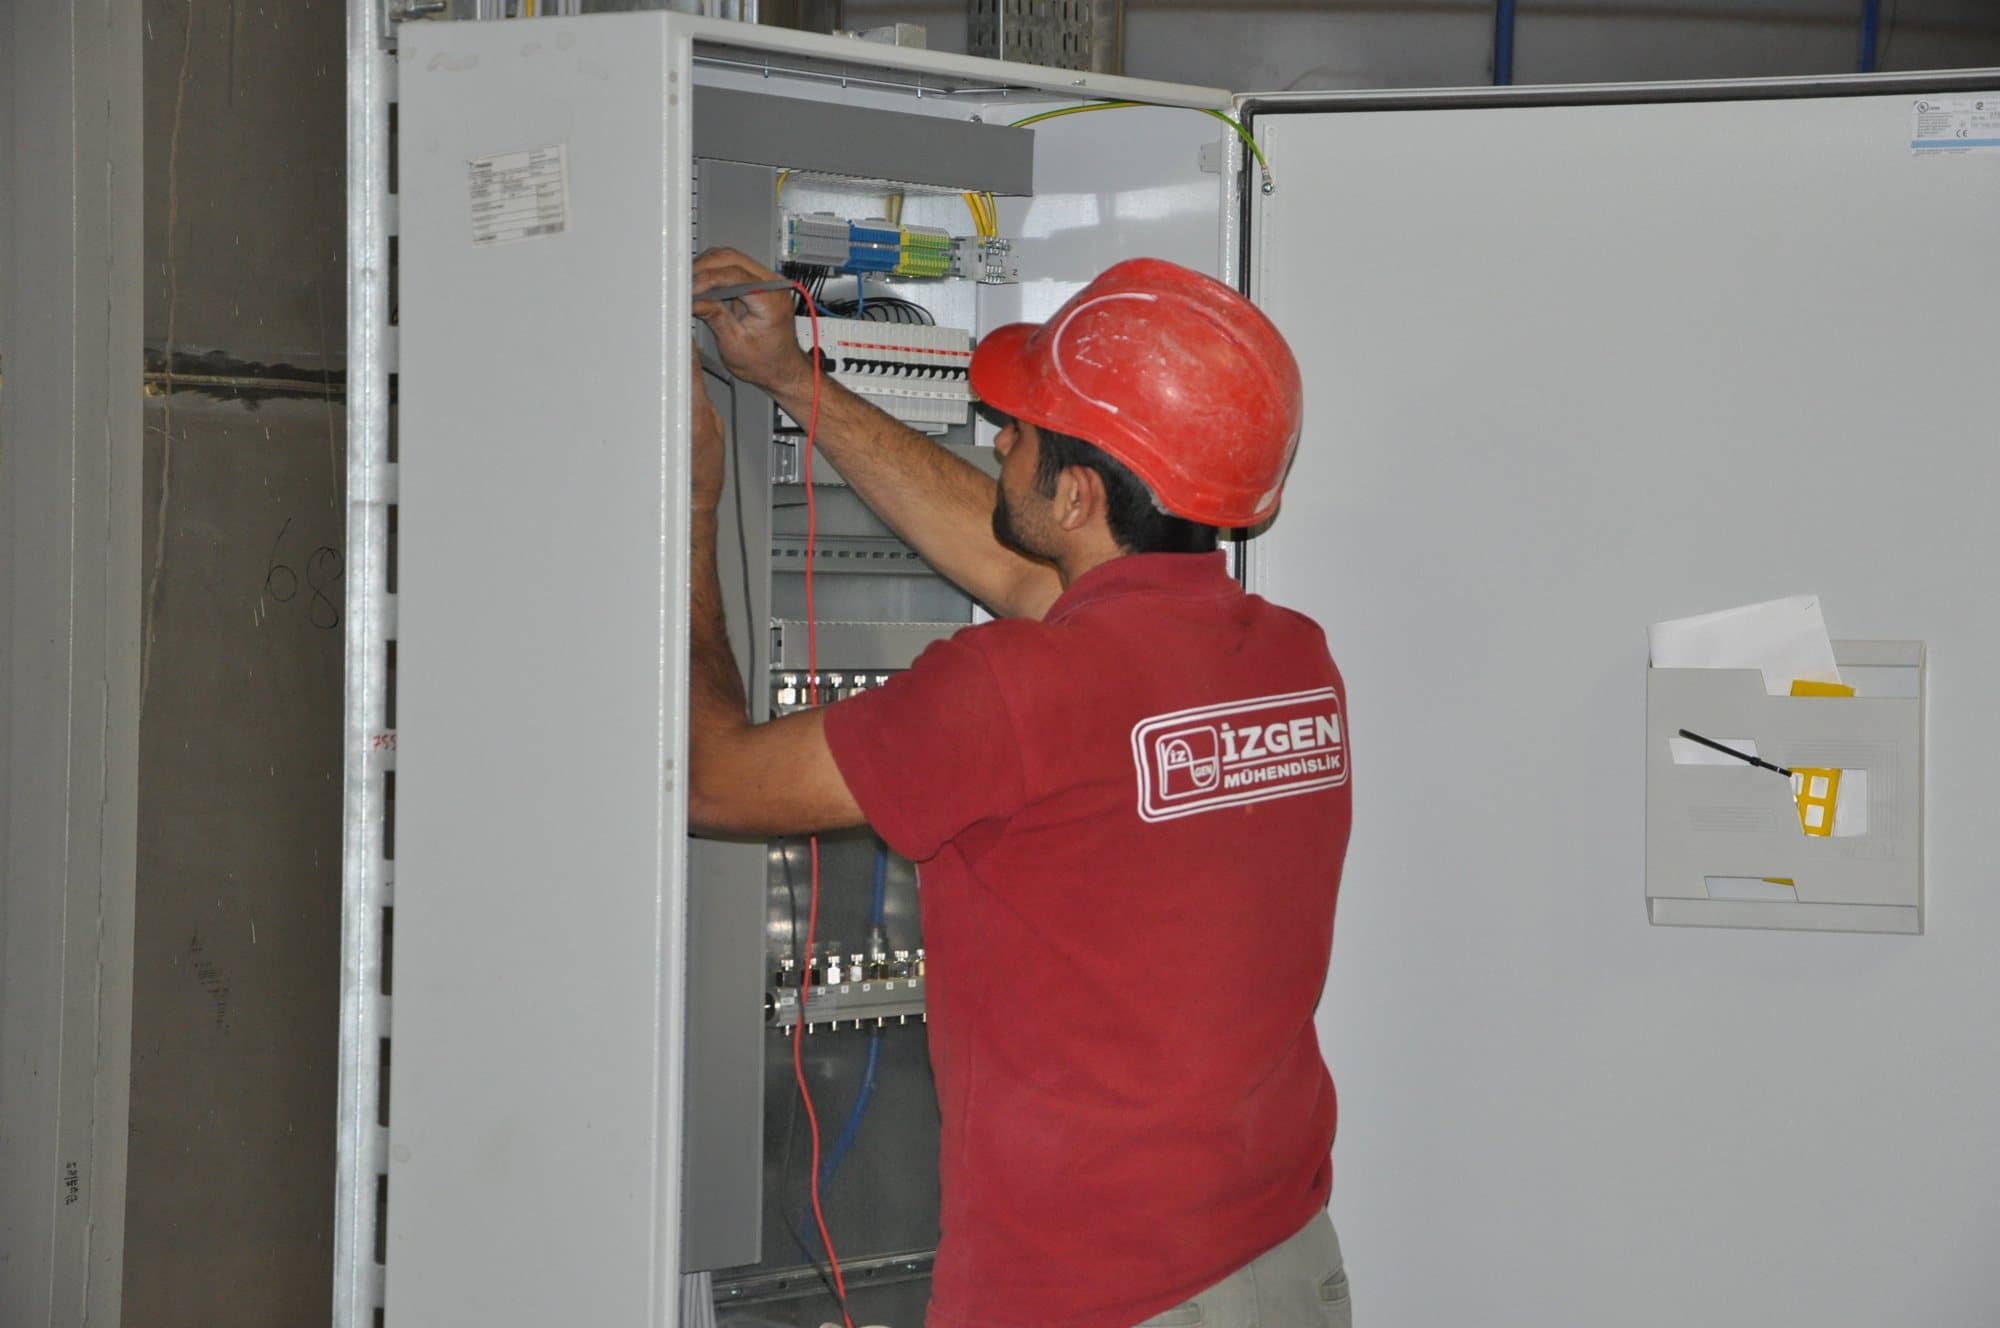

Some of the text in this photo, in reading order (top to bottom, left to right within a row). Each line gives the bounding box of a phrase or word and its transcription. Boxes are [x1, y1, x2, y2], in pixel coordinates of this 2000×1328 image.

[1220, 713, 1342, 764] İZGEN
[1193, 764, 1214, 778] GEN
[1223, 754, 1342, 789] MÜHENDİSLİK
